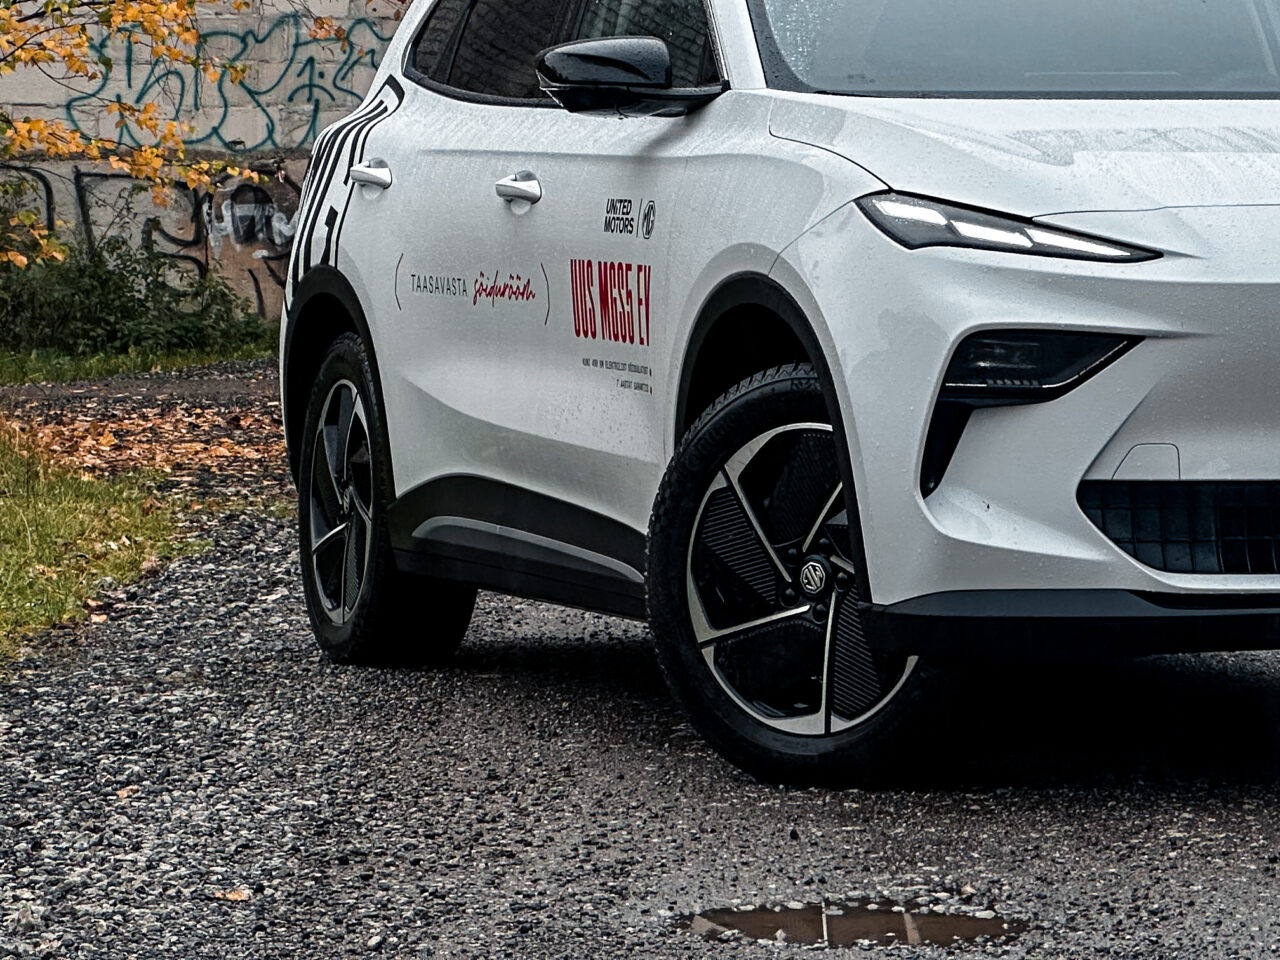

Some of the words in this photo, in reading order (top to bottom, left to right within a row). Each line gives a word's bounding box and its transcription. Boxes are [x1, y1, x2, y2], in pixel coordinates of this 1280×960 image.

[606, 198, 632, 215] UNITED
[603, 215, 634, 234] MOTORS
[411, 274, 468, 297] TAASAVASTA
[570, 259, 597, 339] UUS
